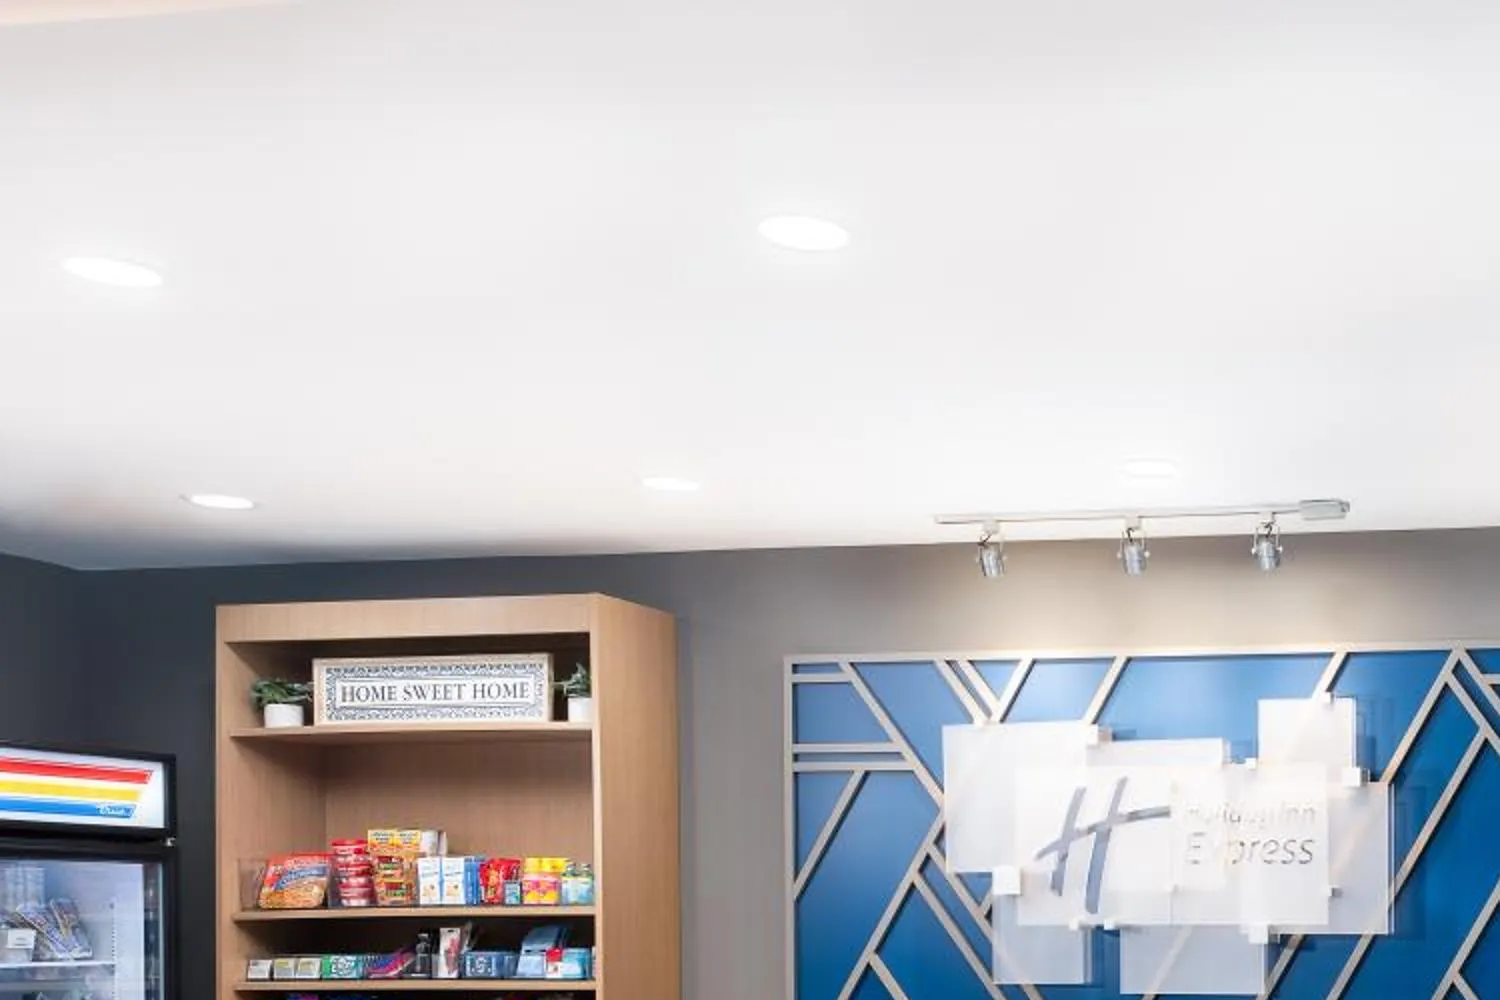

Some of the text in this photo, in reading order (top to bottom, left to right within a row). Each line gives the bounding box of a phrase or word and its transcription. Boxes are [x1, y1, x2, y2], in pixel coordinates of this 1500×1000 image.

[341, 681, 530, 702] HOME SWEET HOME
[1184, 831, 1315, 865] Epress
